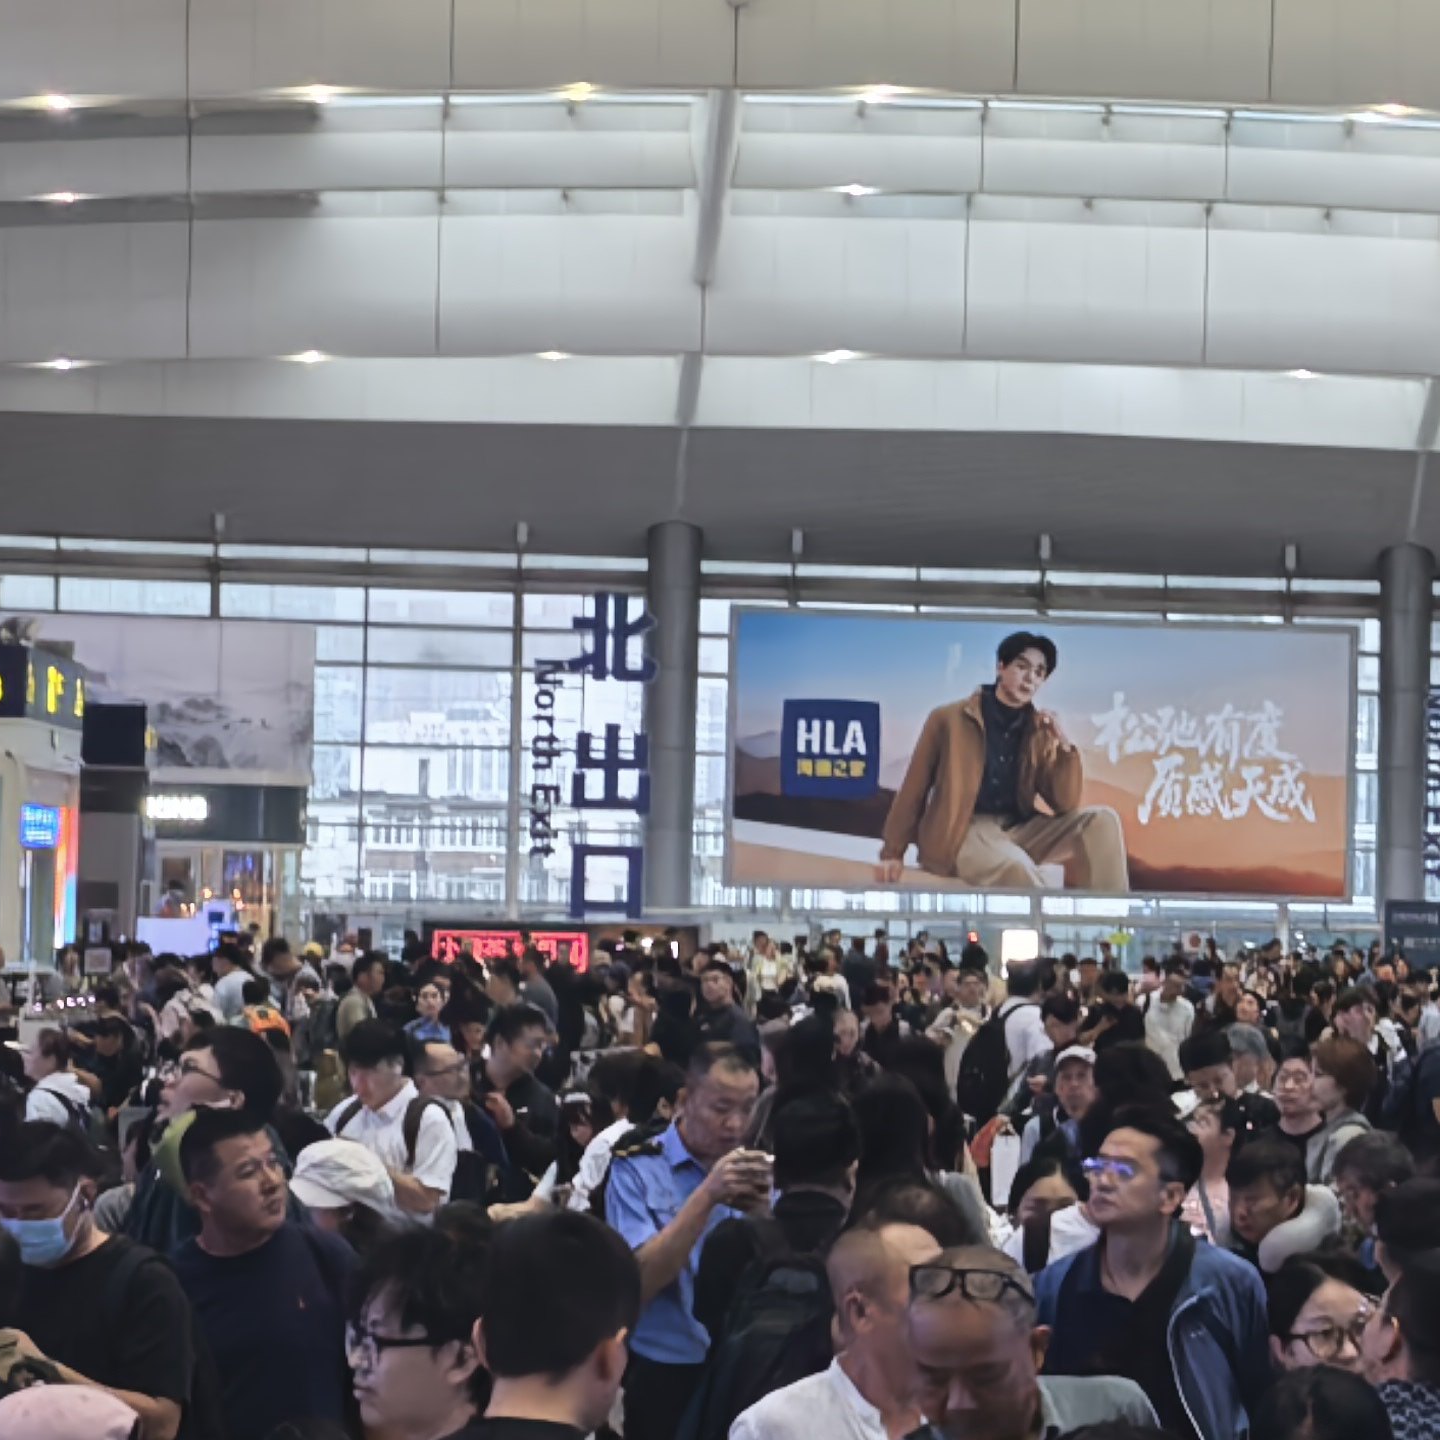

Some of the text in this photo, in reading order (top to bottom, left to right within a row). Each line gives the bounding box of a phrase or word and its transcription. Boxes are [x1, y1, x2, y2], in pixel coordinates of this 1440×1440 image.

[528, 659, 563, 858] North Exit
[568, 592, 658, 918] 北出口
[796, 717, 867, 756] HLA
[1090, 691, 1299, 772] 松弛有度
[1136, 753, 1317, 826] 质感天成
